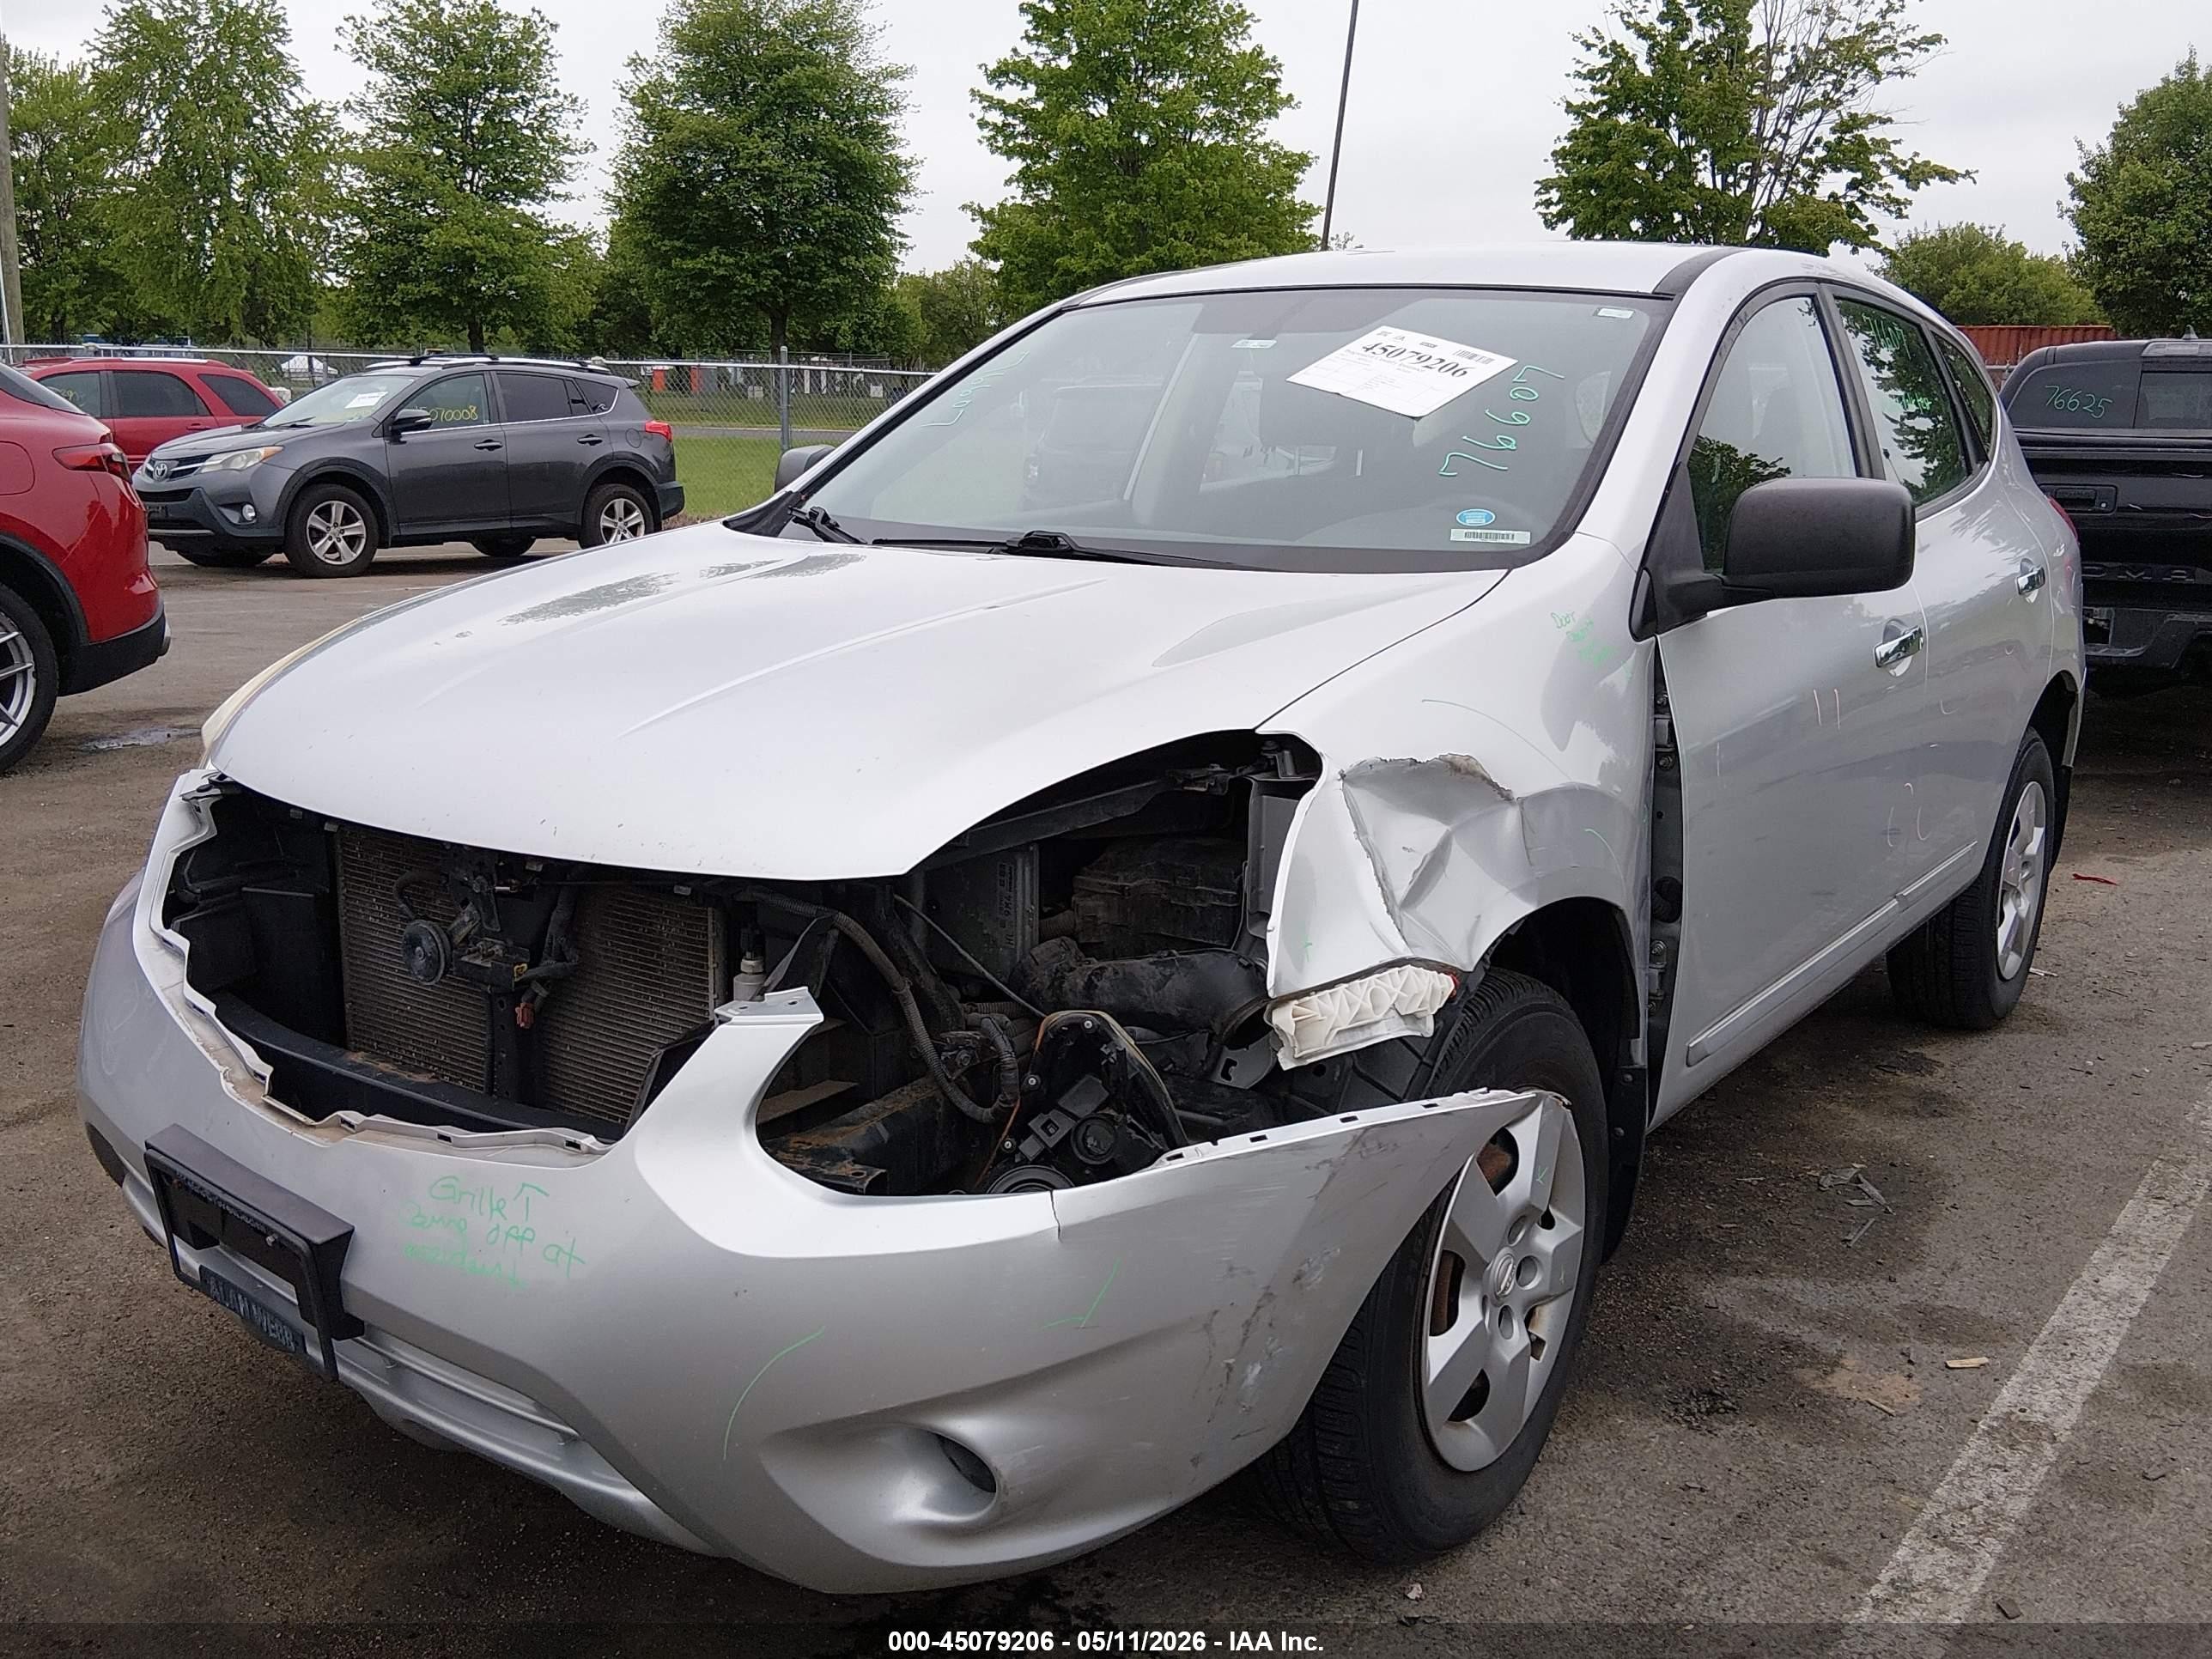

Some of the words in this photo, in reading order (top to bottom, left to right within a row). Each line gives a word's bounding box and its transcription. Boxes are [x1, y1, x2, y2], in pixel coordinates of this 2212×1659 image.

[1362, 343, 1477, 378] 45079206
[413, 404, 478, 422] 070008
[2045, 384, 2114, 419] 76625
[1438, 365, 1565, 477] 76607
[429, 1175, 508, 1222] Grille
